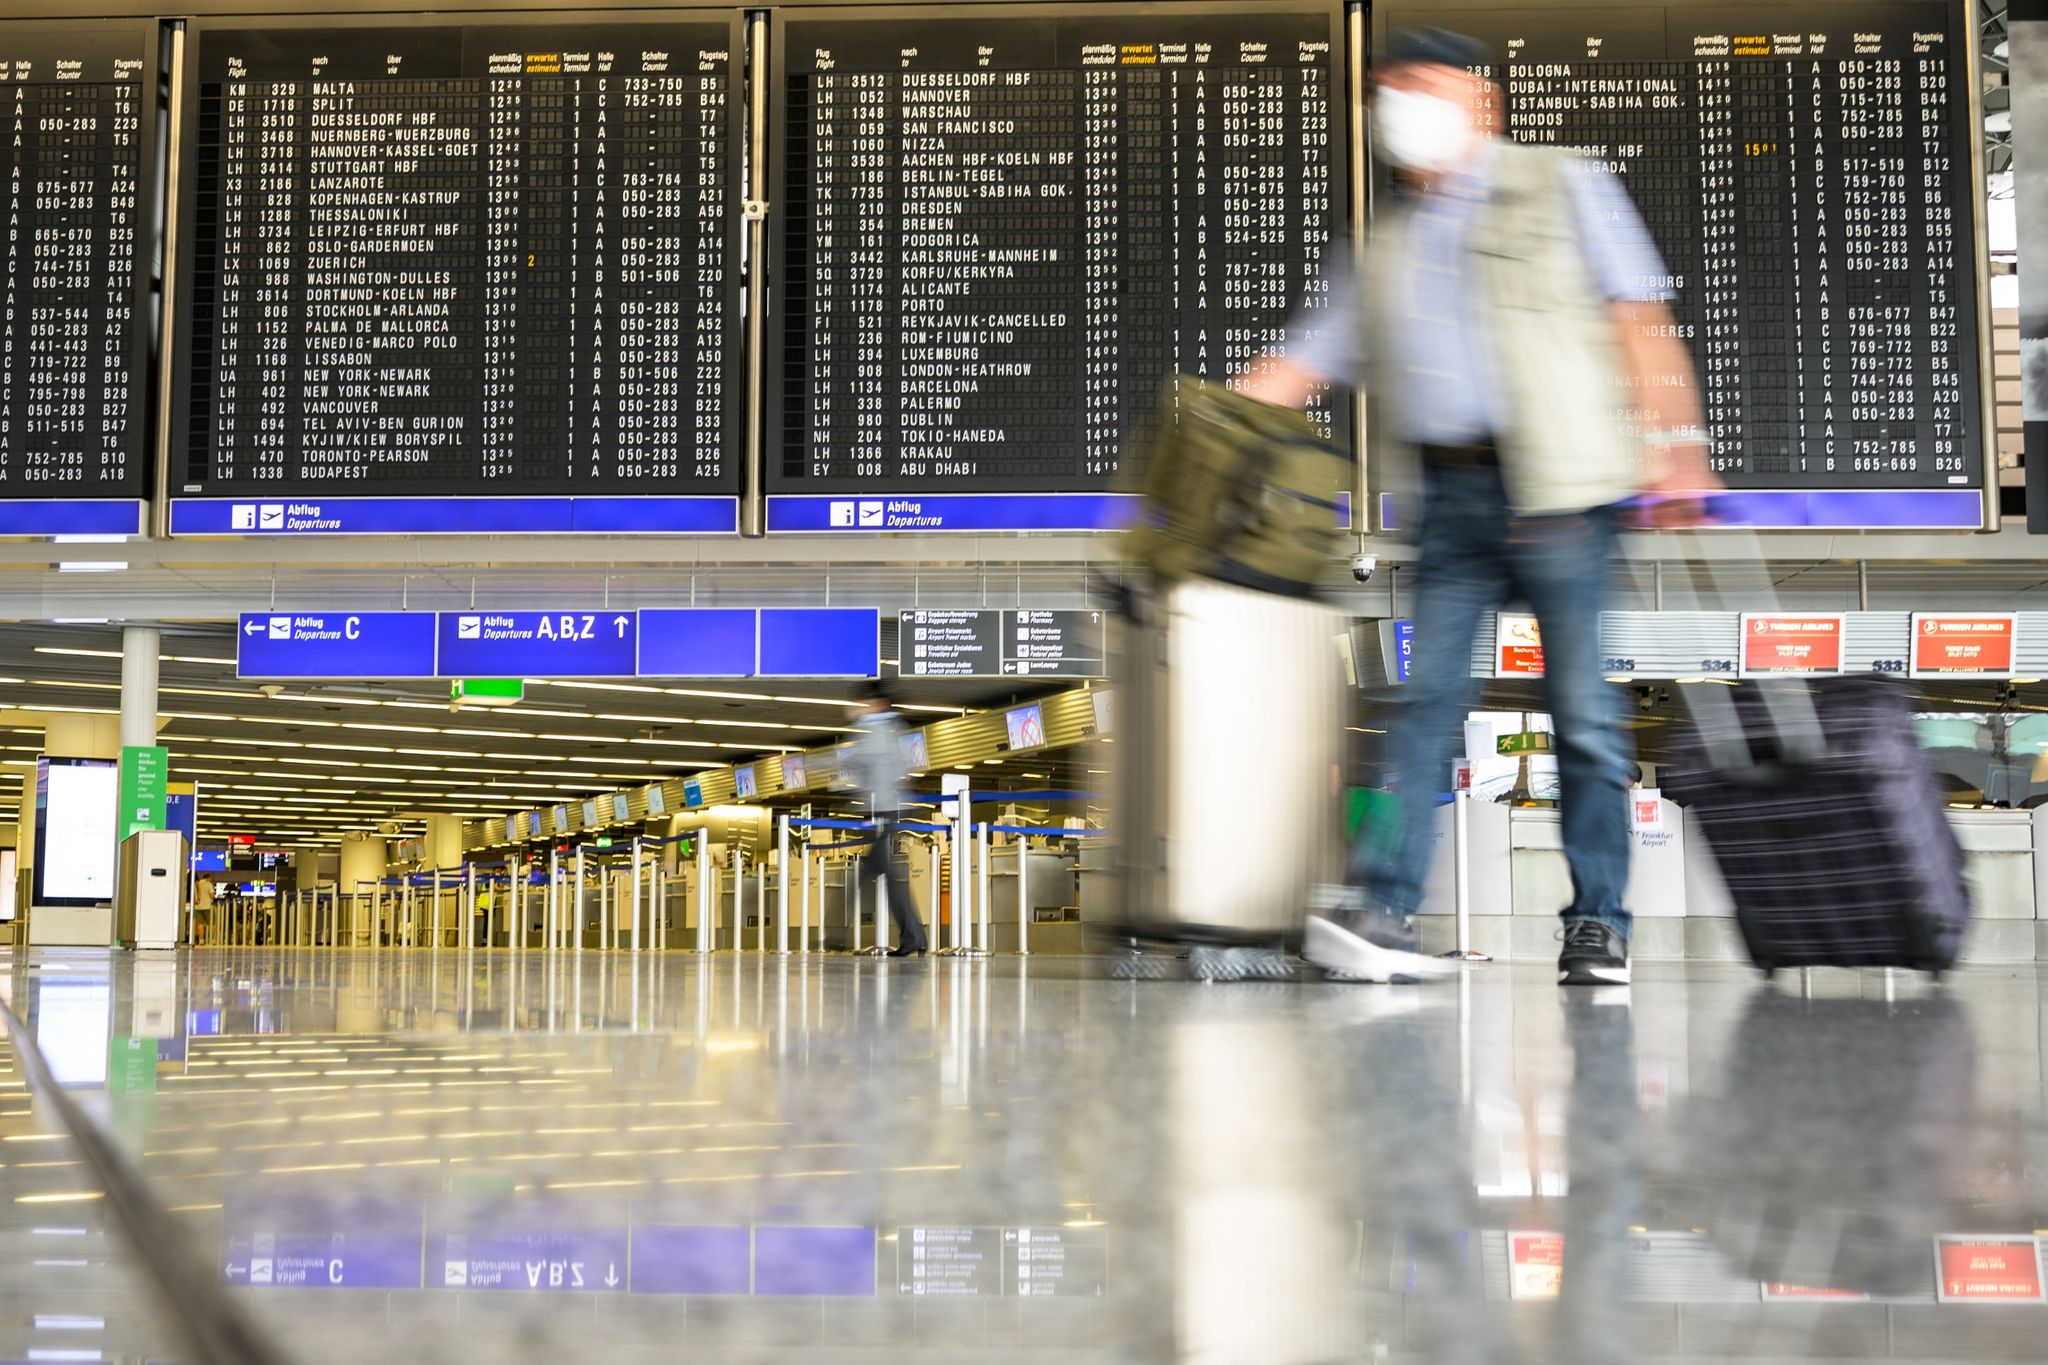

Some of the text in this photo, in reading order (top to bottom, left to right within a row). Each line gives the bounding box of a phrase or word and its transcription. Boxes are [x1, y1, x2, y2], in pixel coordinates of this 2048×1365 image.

[312, 56, 328, 65] nach
[387, 55, 402, 64] über
[489, 54, 521, 64] planmäßig
[527, 54, 557, 62] erwartet
[563, 52, 589, 62] Terminal
[598, 52, 614, 61] Halle
[642, 51, 668, 61] Schalter
[700, 51, 728, 61] Flugsteig
[229, 58, 242, 67] Flug
[489, 64, 521, 73] scheduled
[527, 64, 560, 72] estimated
[564, 63, 590, 72] Terminal
[598, 63, 611, 71] Hall
[642, 62, 667, 71] Counter
[699, 62, 714, 70] Gate
[229, 67, 246, 77] Flight
[313, 67, 320, 76] to
[387, 66, 397, 75] via
[1510, 65, 1571, 77] BOLOGNA
[903, 73, 1030, 87] DUESSELDORF HBF
[313, 83, 354, 95] MALTA
[1510, 80, 1677, 94] DUBAI-INTERNATIONAL
[902, 90, 970, 102] HANNOVER
[1841, 93, 1947, 106] 715-718 B44
[313, 99, 354, 111] SPLIT
[1512, 96, 1685, 110] ISTANBUL-SABIHA GOK.
[902, 106, 971, 118] WARSCHAU
[312, 113, 436, 126] DUESSELDORF HBF
[1511, 113, 1563, 125] RHODOS
[903, 121, 1014, 134] SAN FRANCISCO
[311, 129, 470, 142] NUERNBERG-WUERZBURG
[1512, 130, 1555, 142] TURIN
[902, 139, 945, 150] NIZZA
[311, 144, 478, 158] HANNOVER-KASSEL-GOET
[1619, 145, 1643, 157] HBF
[902, 153, 1074, 166] AACHEN HBF-KOELN HBF
[311, 161, 418, 174] STUTTGART HBF
[903, 169, 1004, 182] BERLIN-TEGEL
[37, 182, 135, 193] 675-677 A24
[311, 177, 384, 190] LANZAROTE
[904, 185, 1073, 198] ISTANBUL-SABIHA GOK.
[310, 193, 460, 206] KOPENHAGEN-KASTRUP
[902, 202, 962, 214] DRESDEN
[310, 209, 407, 221] THESSALONIKI
[309, 224, 459, 237] LEIPZIG-ERFURT HBF
[902, 219, 953, 230] BREMEN
[309, 240, 434, 253] OSLO-GARDERMOEN
[902, 234, 979, 247] PODGORICA
[902, 250, 1057, 263] KARLSRUHE-MANNHEIM
[34, 260, 131, 272] 744-751 B26
[308, 257, 366, 269] ZUERICH
[307, 272, 450, 285] WASHINGTON-DULLES
[902, 266, 1014, 279] KORFU/KERKYRA
[307, 288, 457, 301] DORTMUND-KOELN HBF
[902, 283, 970, 295] ALICANTE
[306, 304, 449, 317] STOCKHOLM-ARLANDA
[902, 300, 944, 311] PORTO
[306, 320, 449, 333] PALMA DE MALLORCA
[902, 315, 1066, 328] REYKJAVIK-CANCELLED
[305, 336, 457, 349] VENEDIG-MARCO POLO
[901, 331, 1013, 344] ROM-FIUMICINO
[30, 340, 120, 352] 441-443 C1
[305, 353, 372, 365] LISSABON
[902, 348, 978, 360] LUXEMBURG
[304, 369, 431, 381] NEW YORK-NEWARK
[901, 364, 1031, 377] LONDON-HEATHROW
[901, 381, 978, 393] BARCELONA
[304, 402, 378, 414] VANCOUVER
[901, 398, 961, 409] PALERMO
[304, 417, 464, 430] TEL AVIV-BEN GURION
[901, 414, 952, 426] DUBLIN
[902, 430, 1005, 442] TOKIO-HANEDA
[1672, 426, 1697, 436] HBF
[303, 434, 462, 447] KYJIW/KIEW BORYSPIL
[303, 450, 428, 463] TORONTO-PEARSON
[901, 447, 952, 459] KRAKAU
[900, 463, 977, 475] ABU DHABI
[1854, 458, 1962, 470] 665-669 B26
[301, 466, 368, 479] BUDAPEST
[287, 505, 320, 517] Abflug
[887, 501, 921, 513] Abflug
[287, 517, 341, 530] Departures
[887, 515, 942, 528] Departures
[295, 617, 323, 629] Abflug
[345, 617, 360, 639] C
[484, 616, 513, 628] Abflug
[1940, 622, 2004, 631] TURKISH AIRLINES
[484, 629, 532, 641] Departures
[537, 616, 595, 642] A,B,Z
[295, 630, 341, 641] Departures
[1702, 660, 1732, 671] 534
[1873, 661, 1903, 671] 533
[1642, 839, 1666, 847] Airport
